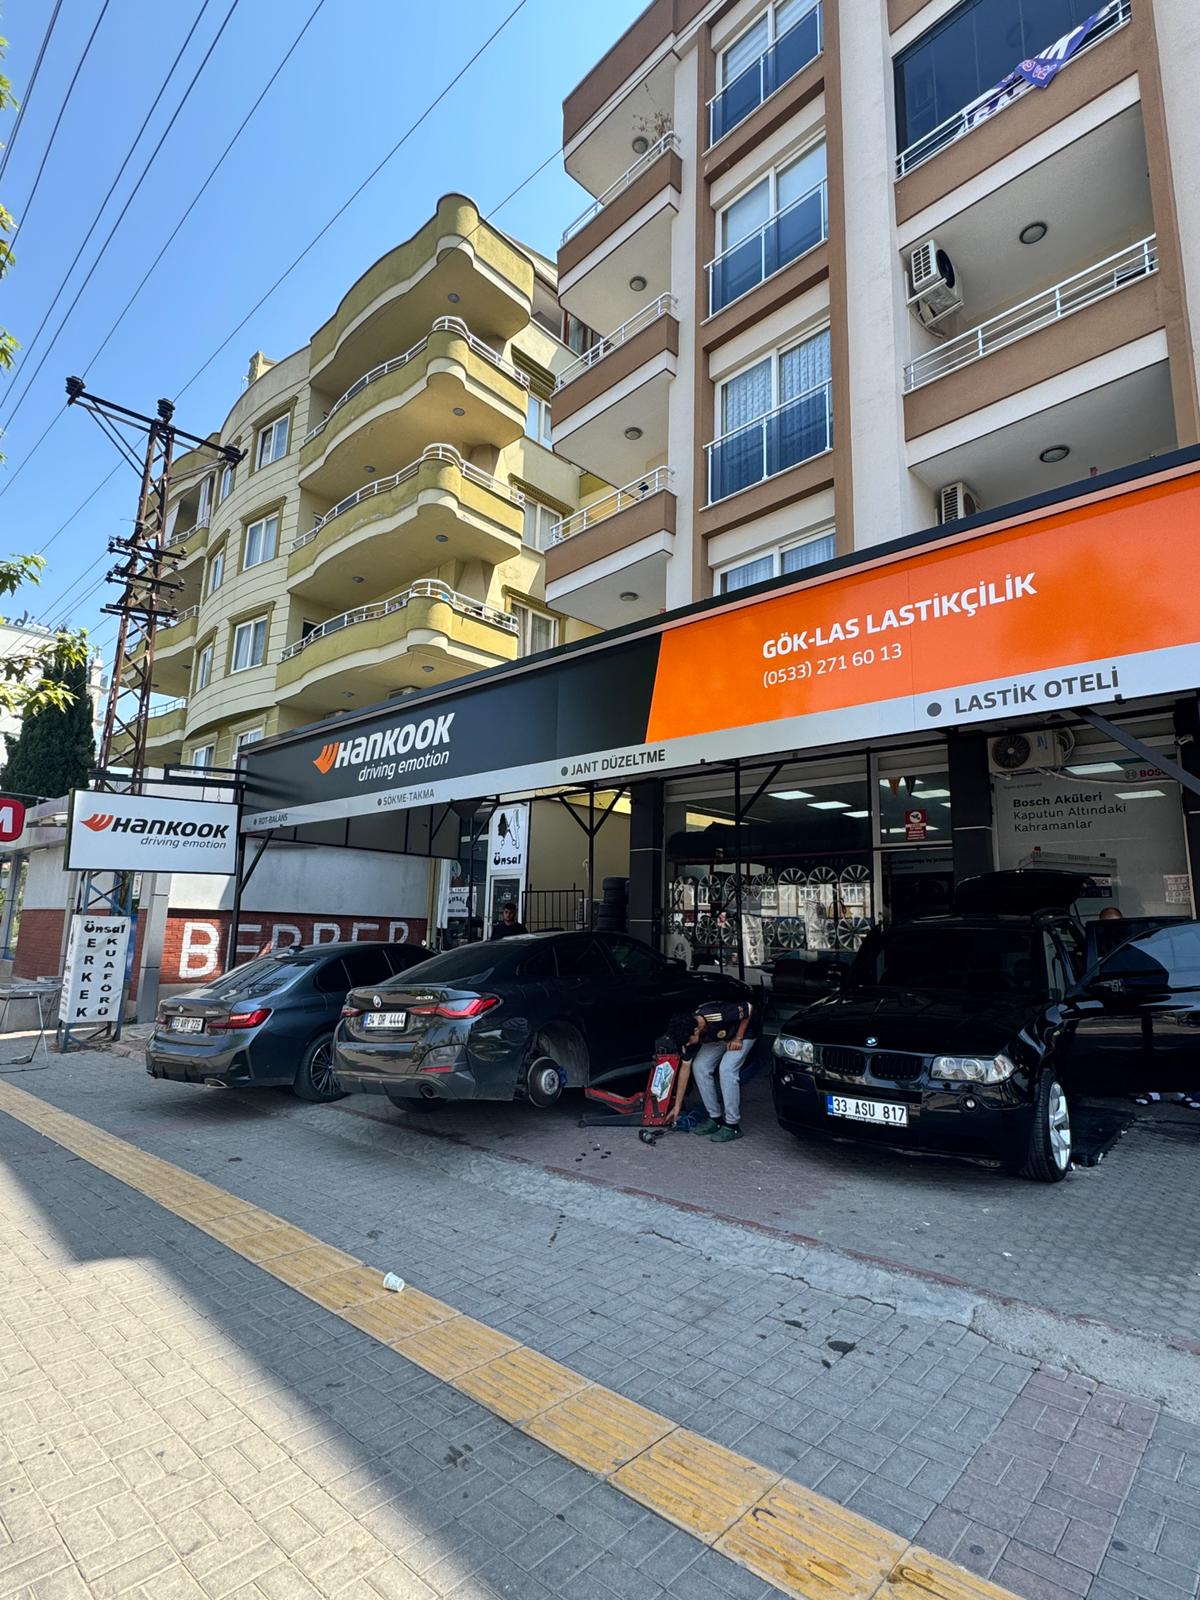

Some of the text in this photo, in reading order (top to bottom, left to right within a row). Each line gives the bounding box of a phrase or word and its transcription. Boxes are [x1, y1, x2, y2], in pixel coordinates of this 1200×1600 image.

[763, 571, 1037, 658] GÖK-LAS LASTİKÇİLİK
[763, 643, 903, 689] (0533) 271 60 13
[955, 666, 1120, 715] LASTİK OTELİ
[358, 751, 448, 783] driving emotion
[571, 749, 666, 776] JANT DÜZELTME
[384, 789, 434, 806] SÖKME-TAKMA
[1013, 792, 1103, 808] Bosch Aküleri
[1014, 804, 1126, 822] Kaputun Altındaki
[1014, 820, 1093, 833] Kahramanlar
[141, 837, 226, 849] driving emotion
[493, 852, 521, 865] Ünsal
[84, 920, 125, 933] Ünsal
[76, 938, 97, 1018] ERKEK
[98, 938, 118, 1016] KUAFÖRÜ
[367, 1013, 375, 1025] 34
[389, 1013, 404, 1024] 4444
[834, 1098, 848, 1112] 33
[855, 1102, 875, 1117] ASU
[883, 1106, 904, 1121] 817
